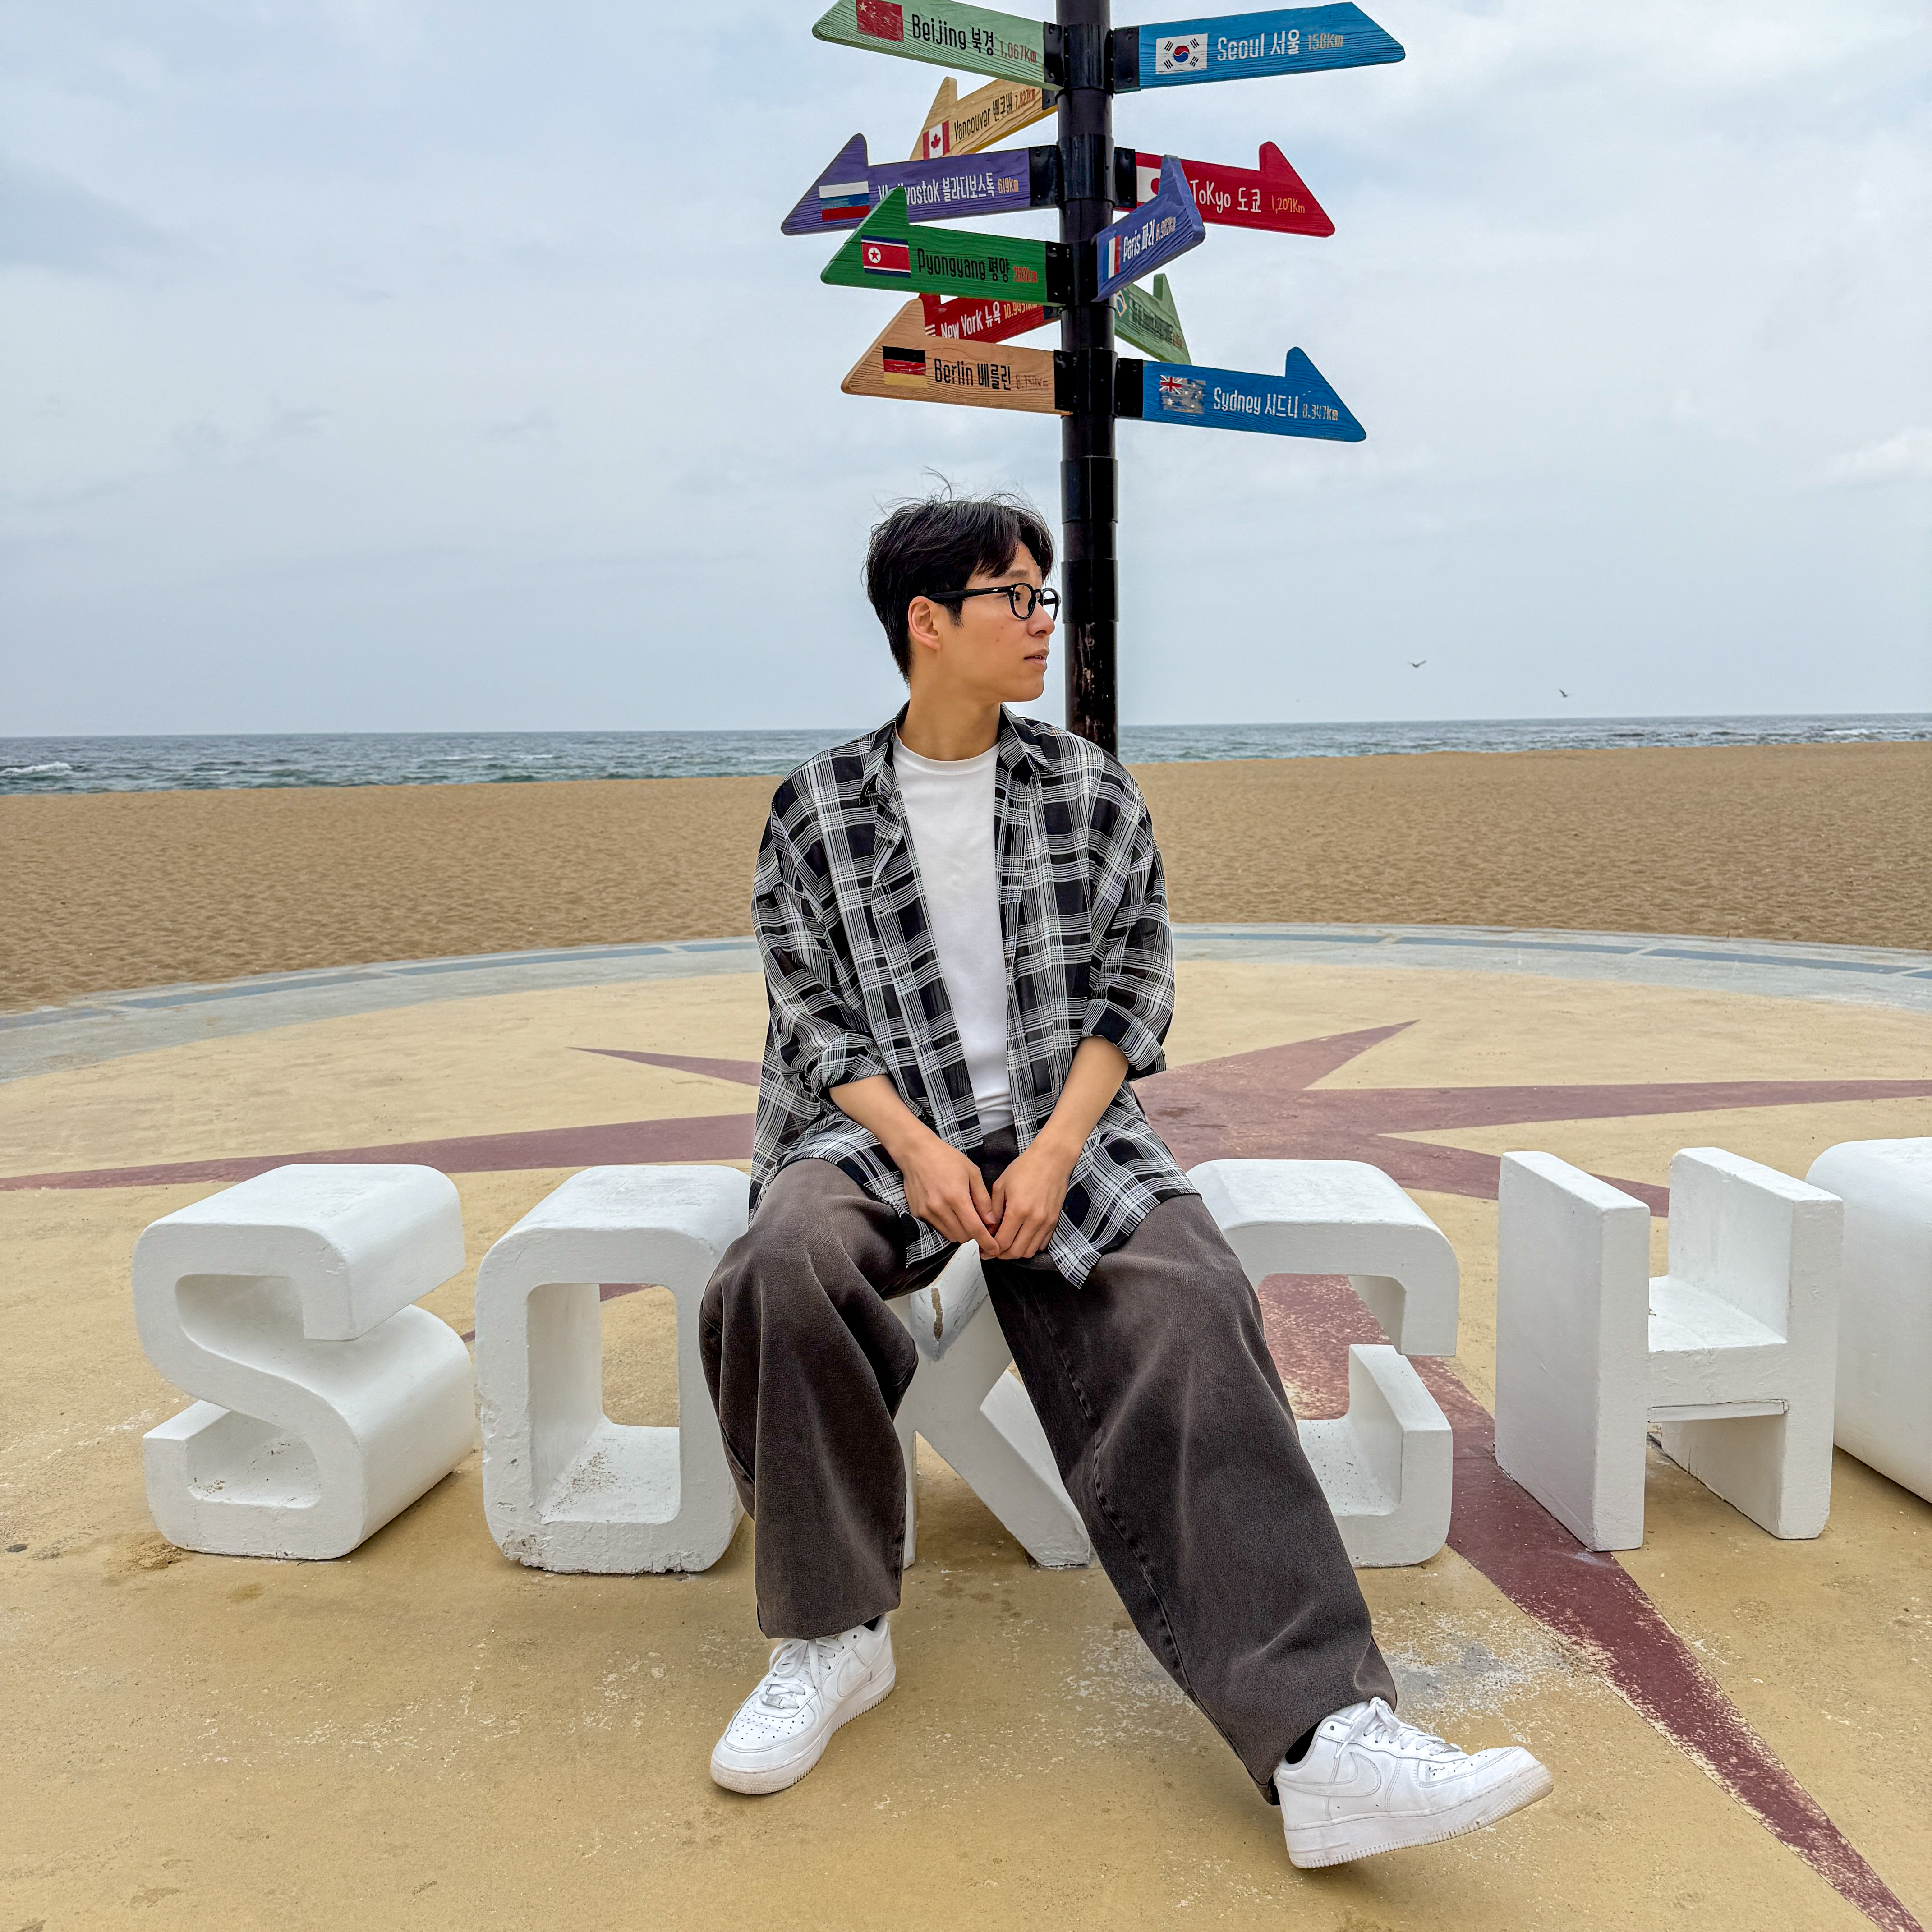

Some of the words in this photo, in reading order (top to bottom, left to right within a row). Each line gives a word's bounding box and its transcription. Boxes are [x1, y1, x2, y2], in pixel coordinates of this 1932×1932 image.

[911, 14, 966, 50] Beijing
[971, 27, 994, 56] 북경
[1217, 33, 1265, 62] Seoul
[1270, 29, 1300, 55] 서울
[954, 108, 991, 142] Vancouver
[942, 172, 995, 202] 블라디보스톡
[1237, 187, 1262, 212] 도쿄
[1123, 230, 1141, 262] Paris
[1141, 218, 1155, 251] 파리
[917, 248, 986, 281] Pyongyang
[987, 256, 1010, 283] 평양
[940, 320, 960, 340] New
[960, 309, 984, 336] York
[984, 301, 1001, 328] 뉴욕
[934, 358, 974, 386] Berlin
[976, 363, 1012, 391] 베를린
[1213, 387, 1261, 415] Sydney
[1264, 393, 1299, 419] 시드니
